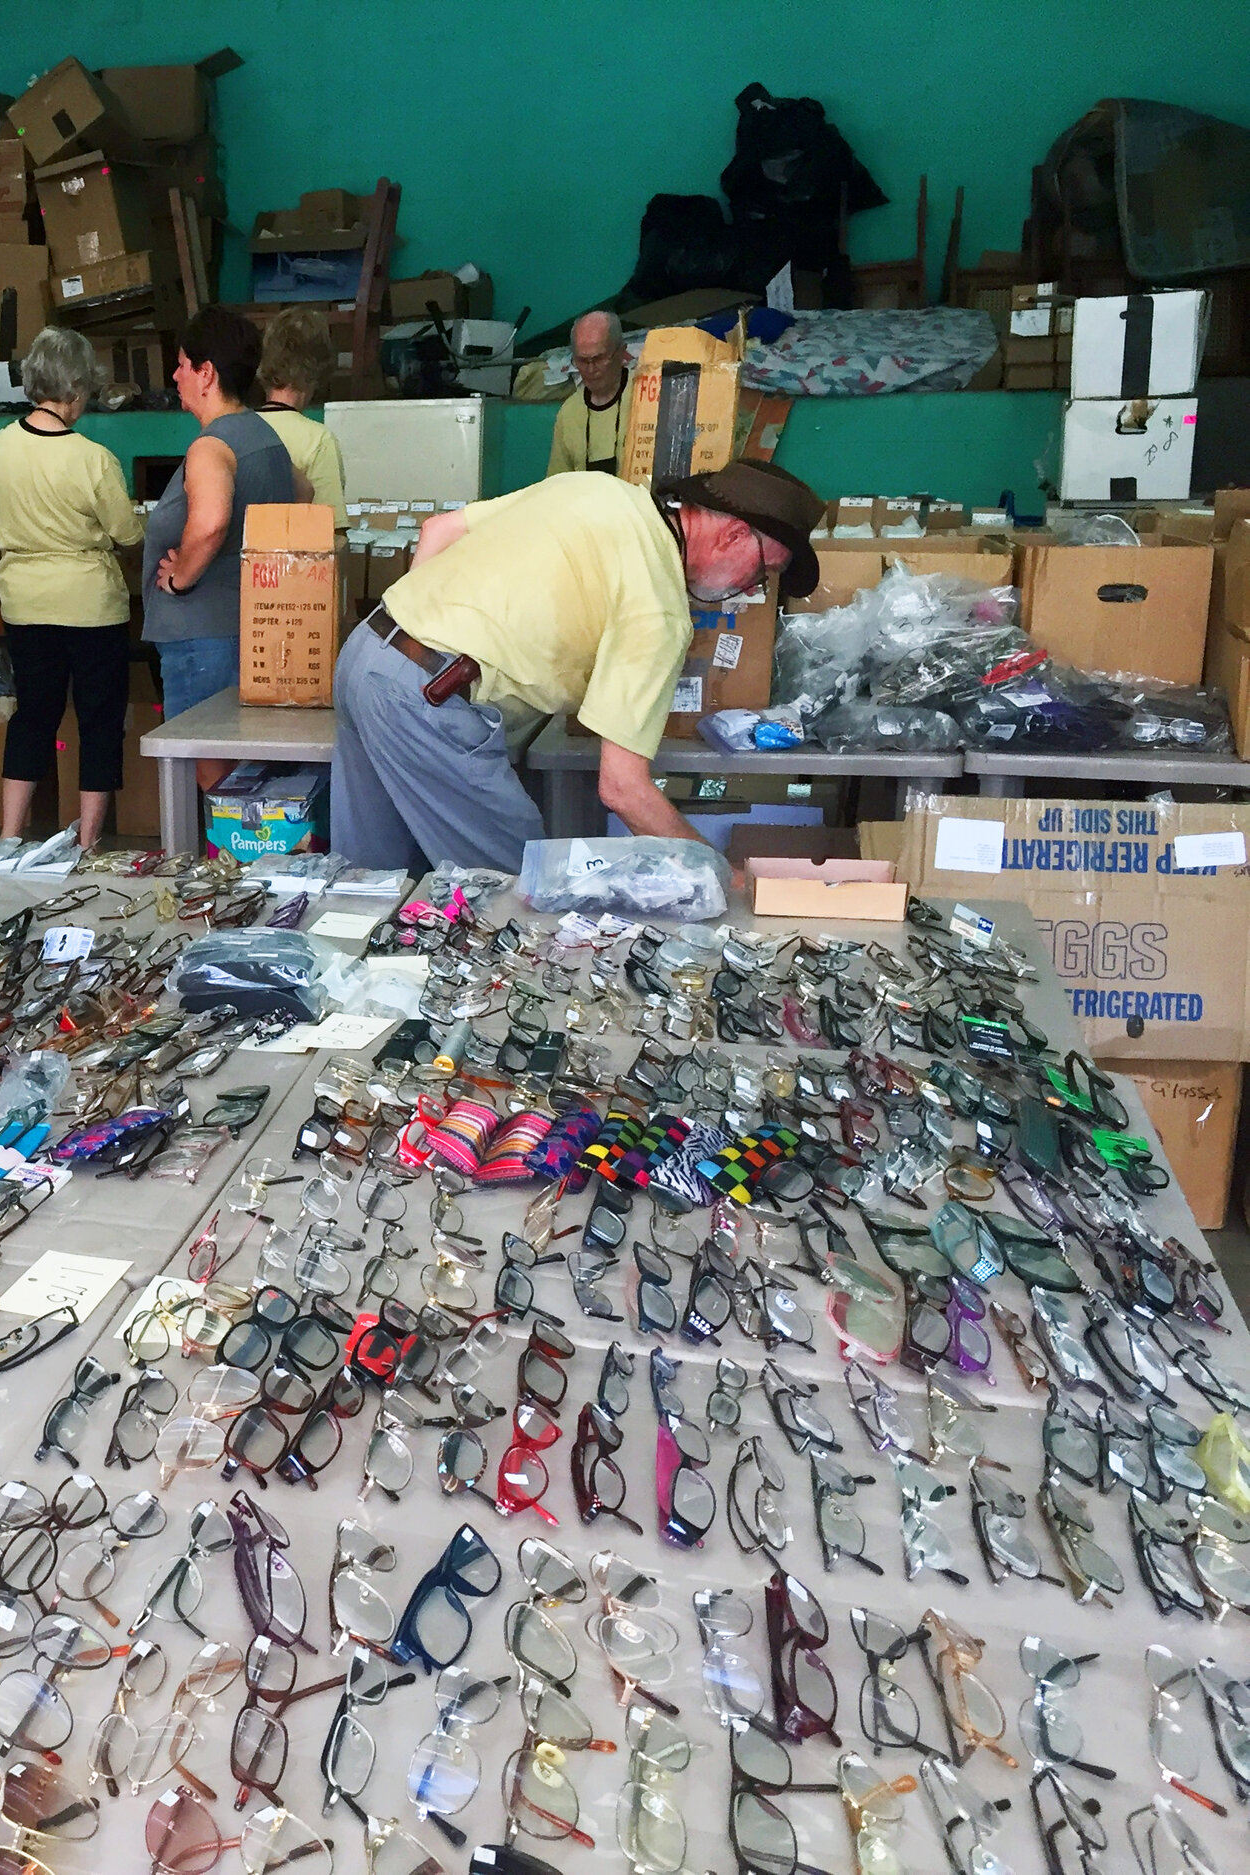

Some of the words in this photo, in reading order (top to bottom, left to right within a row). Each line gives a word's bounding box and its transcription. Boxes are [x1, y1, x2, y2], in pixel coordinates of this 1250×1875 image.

[1038, 807, 1065, 833] UP
[1072, 808, 1111, 834] SIDE
[1117, 809, 1159, 836] THIS
[230, 831, 288, 854] Pampers
